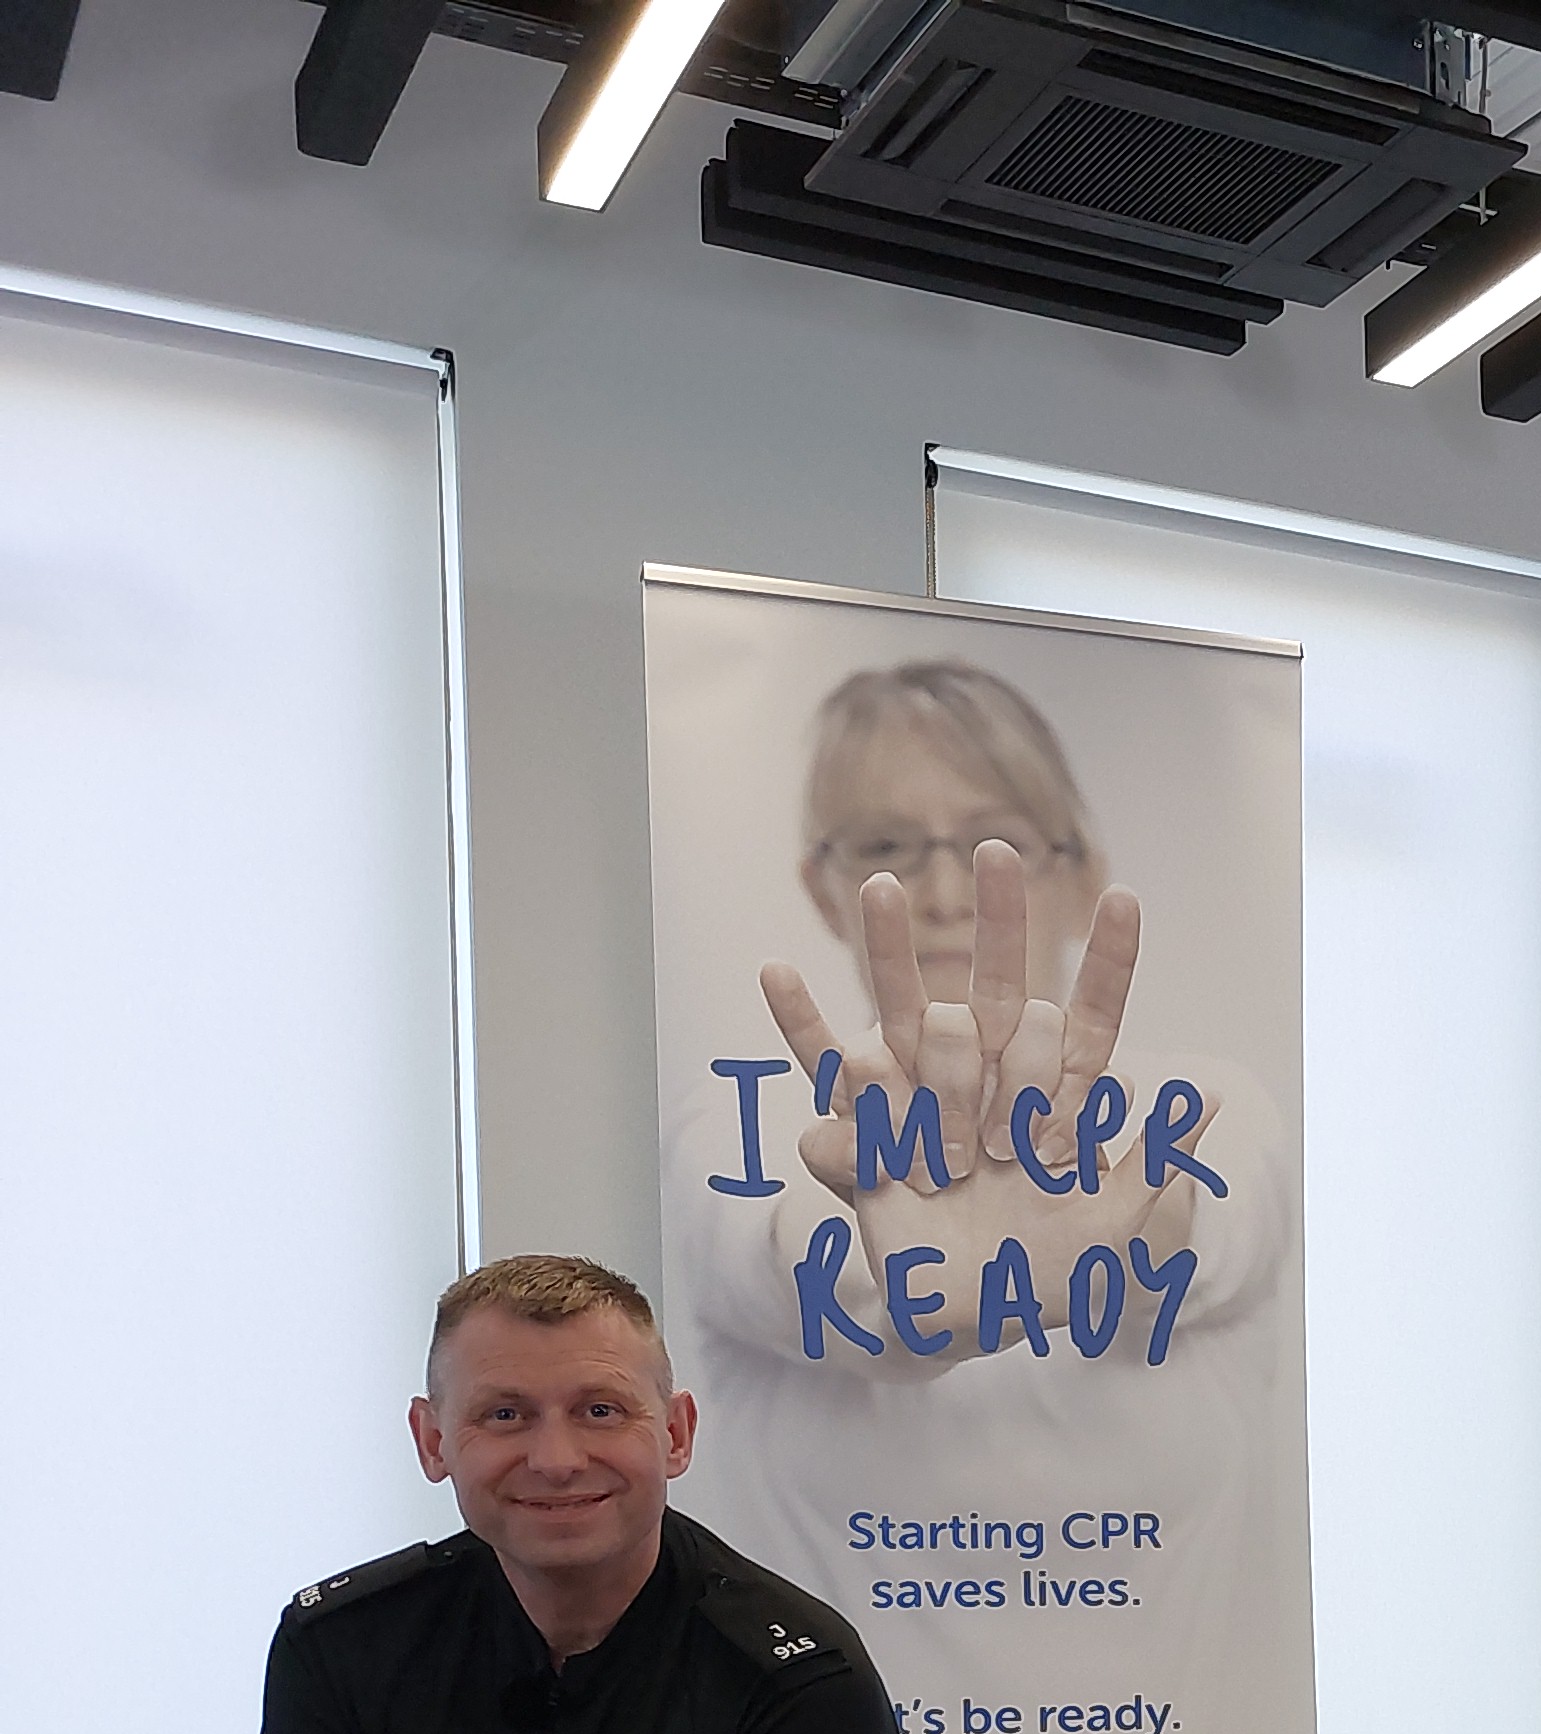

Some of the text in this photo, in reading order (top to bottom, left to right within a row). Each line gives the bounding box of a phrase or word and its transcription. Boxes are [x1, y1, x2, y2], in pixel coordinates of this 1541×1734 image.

[708, 1050, 1228, 1197] I'M CPR
[793, 1217, 1198, 1366] READY
[848, 1511, 1162, 1560] Starting CPR
[871, 1570, 1141, 1609] saves lives.
[772, 1636, 817, 1660] 915
[963, 1698, 1022, 1734] be
